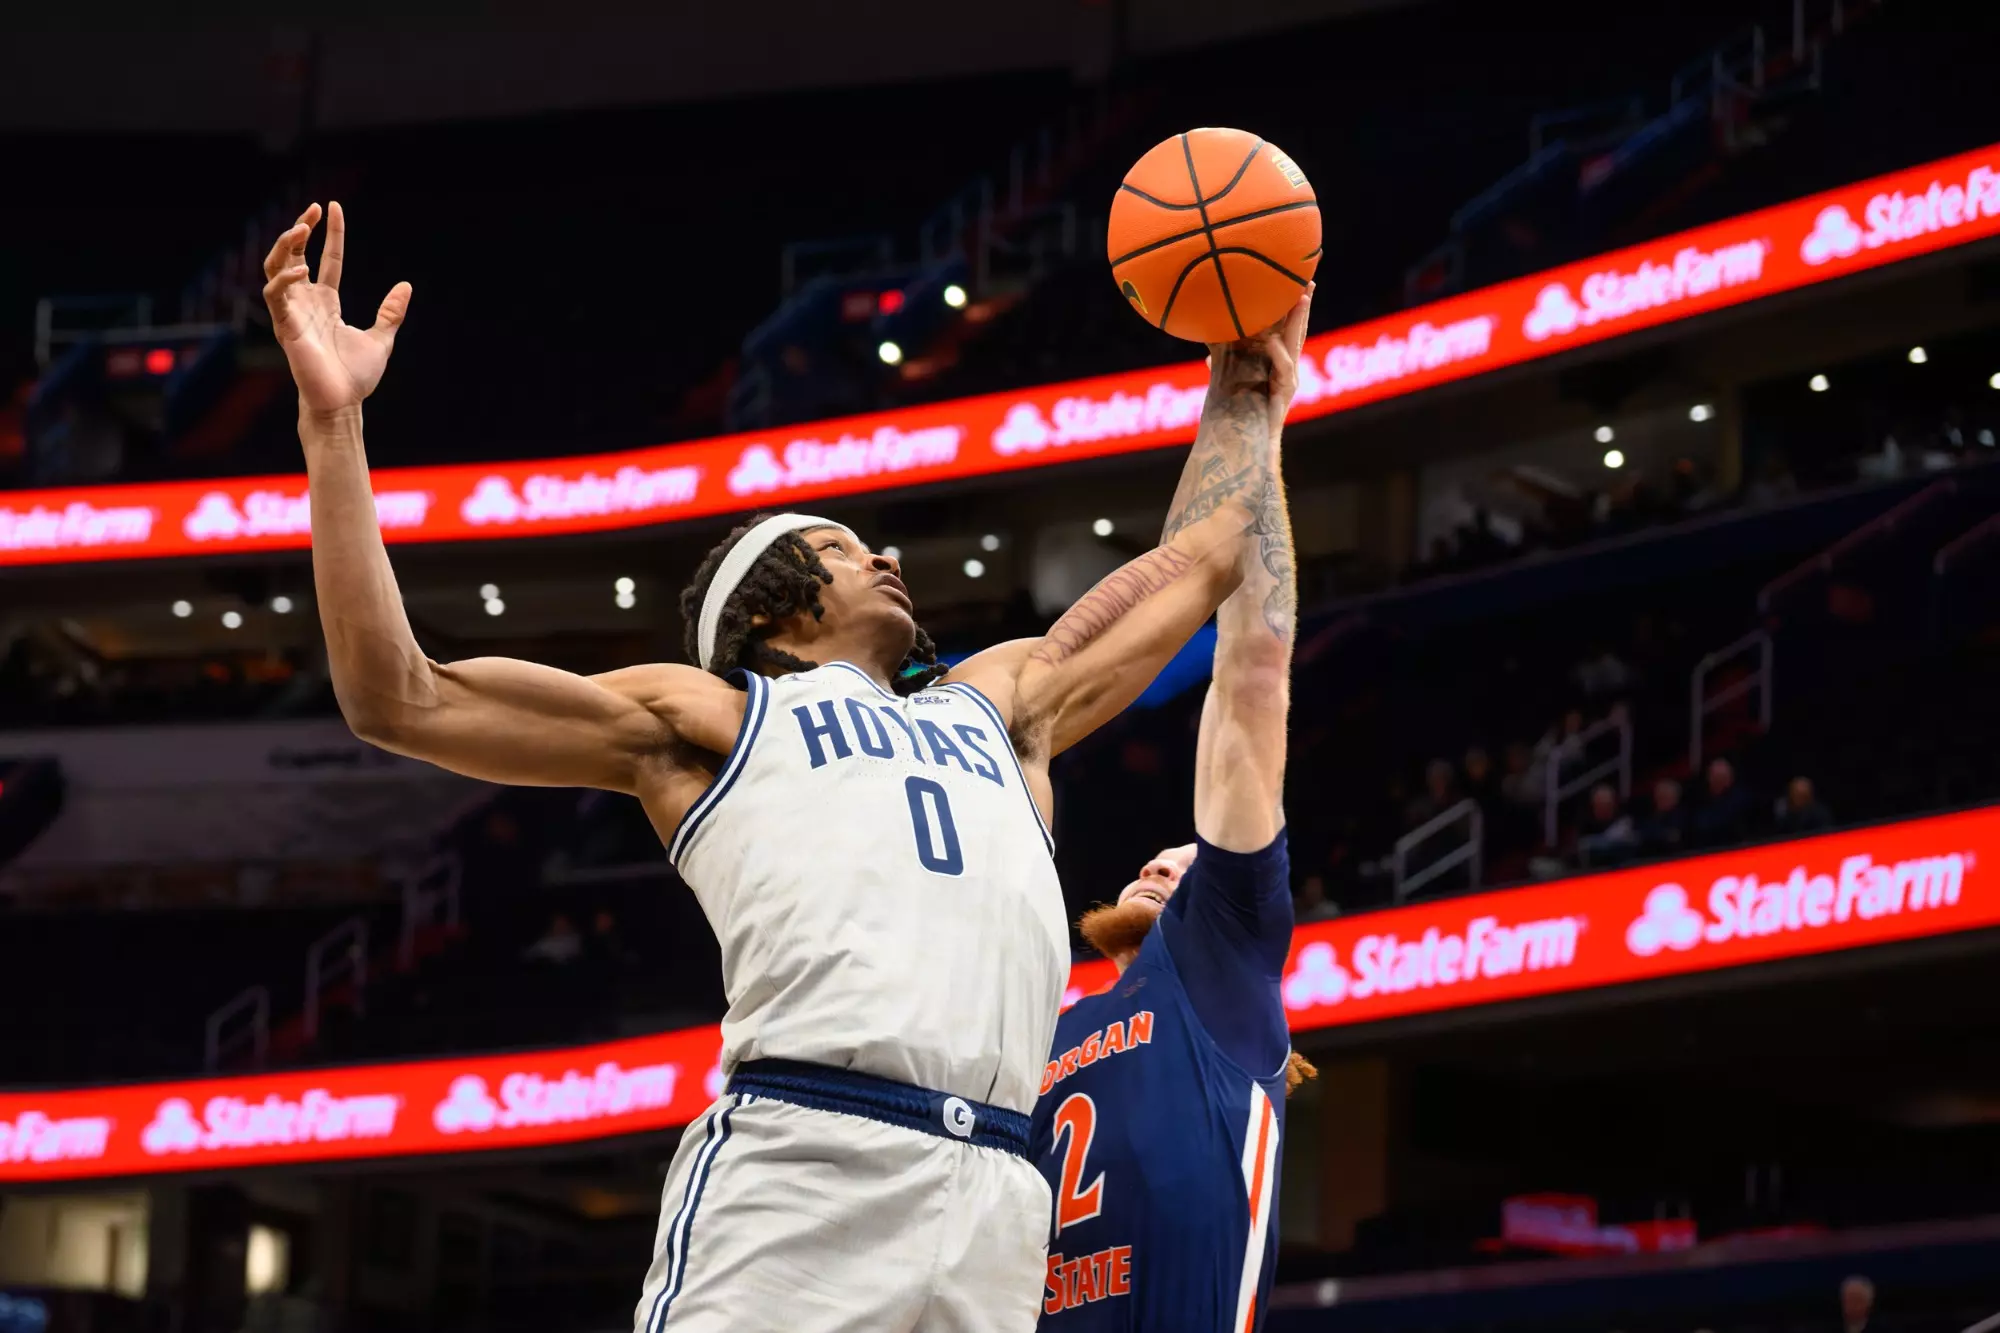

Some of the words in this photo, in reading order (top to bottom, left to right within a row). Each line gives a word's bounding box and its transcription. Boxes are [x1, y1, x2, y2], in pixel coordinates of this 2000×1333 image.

[791, 697, 1004, 788] HOYAS
[904, 774, 965, 879] 0
[1038, 1010, 1154, 1096] ORGAN
[943, 1096, 976, 1139] G
[1051, 1092, 1105, 1239] 2
[1044, 1247, 1132, 1315] STATE
